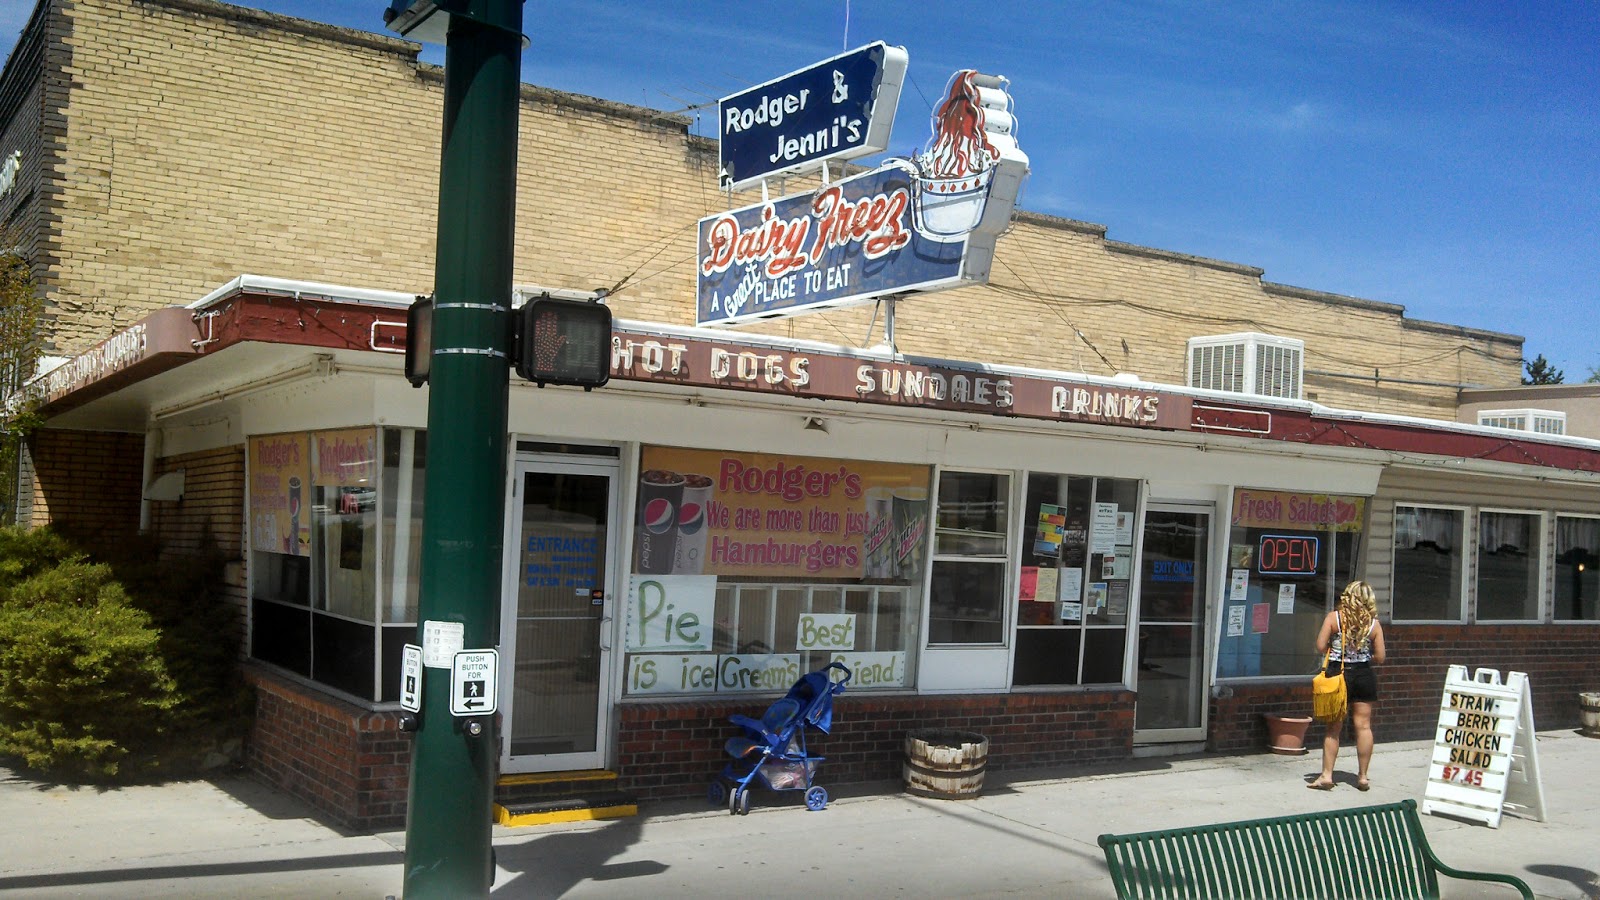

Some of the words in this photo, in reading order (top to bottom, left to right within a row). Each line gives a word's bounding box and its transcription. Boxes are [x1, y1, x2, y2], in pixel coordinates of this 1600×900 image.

[726, 89, 810, 135] Rodger
[832, 69, 849, 104] &
[770, 114, 862, 163] Jenni's
[702, 200, 809, 279] Dairy
[809, 183, 912, 259] Freez
[711, 291, 720, 313] A
[724, 263, 762, 318] Great
[754, 274, 797, 305] PLACE
[804, 269, 822, 295] TO
[826, 263, 852, 291] EAT
[612, 336, 687, 374] HOT
[711, 348, 809, 386] DOGS
[856, 365, 1013, 407] SUNDAES
[1052, 386, 1158, 421] DRINKS
[719, 458, 864, 501] Rodger's
[706, 500, 729, 529] We
[735, 506, 760, 530] are
[766, 508, 801, 532] more
[809, 505, 840, 534] than
[844, 507, 870, 538] just
[1233, 492, 1283, 524] Fresh
[1288, 496, 1337, 525] Salads
[528, 536, 598, 554] ENTRANCE
[711, 535, 859, 572] Hamburgers
[1261, 538, 1316, 572] OPEN
[1153, 560, 1172, 574] EXIT
[1173, 561, 1193, 575] ONLY
[639, 580, 700, 646] Pie
[800, 615, 853, 648] Best
[633, 657, 658, 690] is
[681, 657, 716, 688] ice
[1450, 693, 1500, 713] STRAW-
[1457, 712, 1500, 731] BERRY
[1445, 729, 1501, 751] CHICKEN
[1450, 748, 1491, 769] SALAD
[1442, 766, 1483, 787] $7.45
